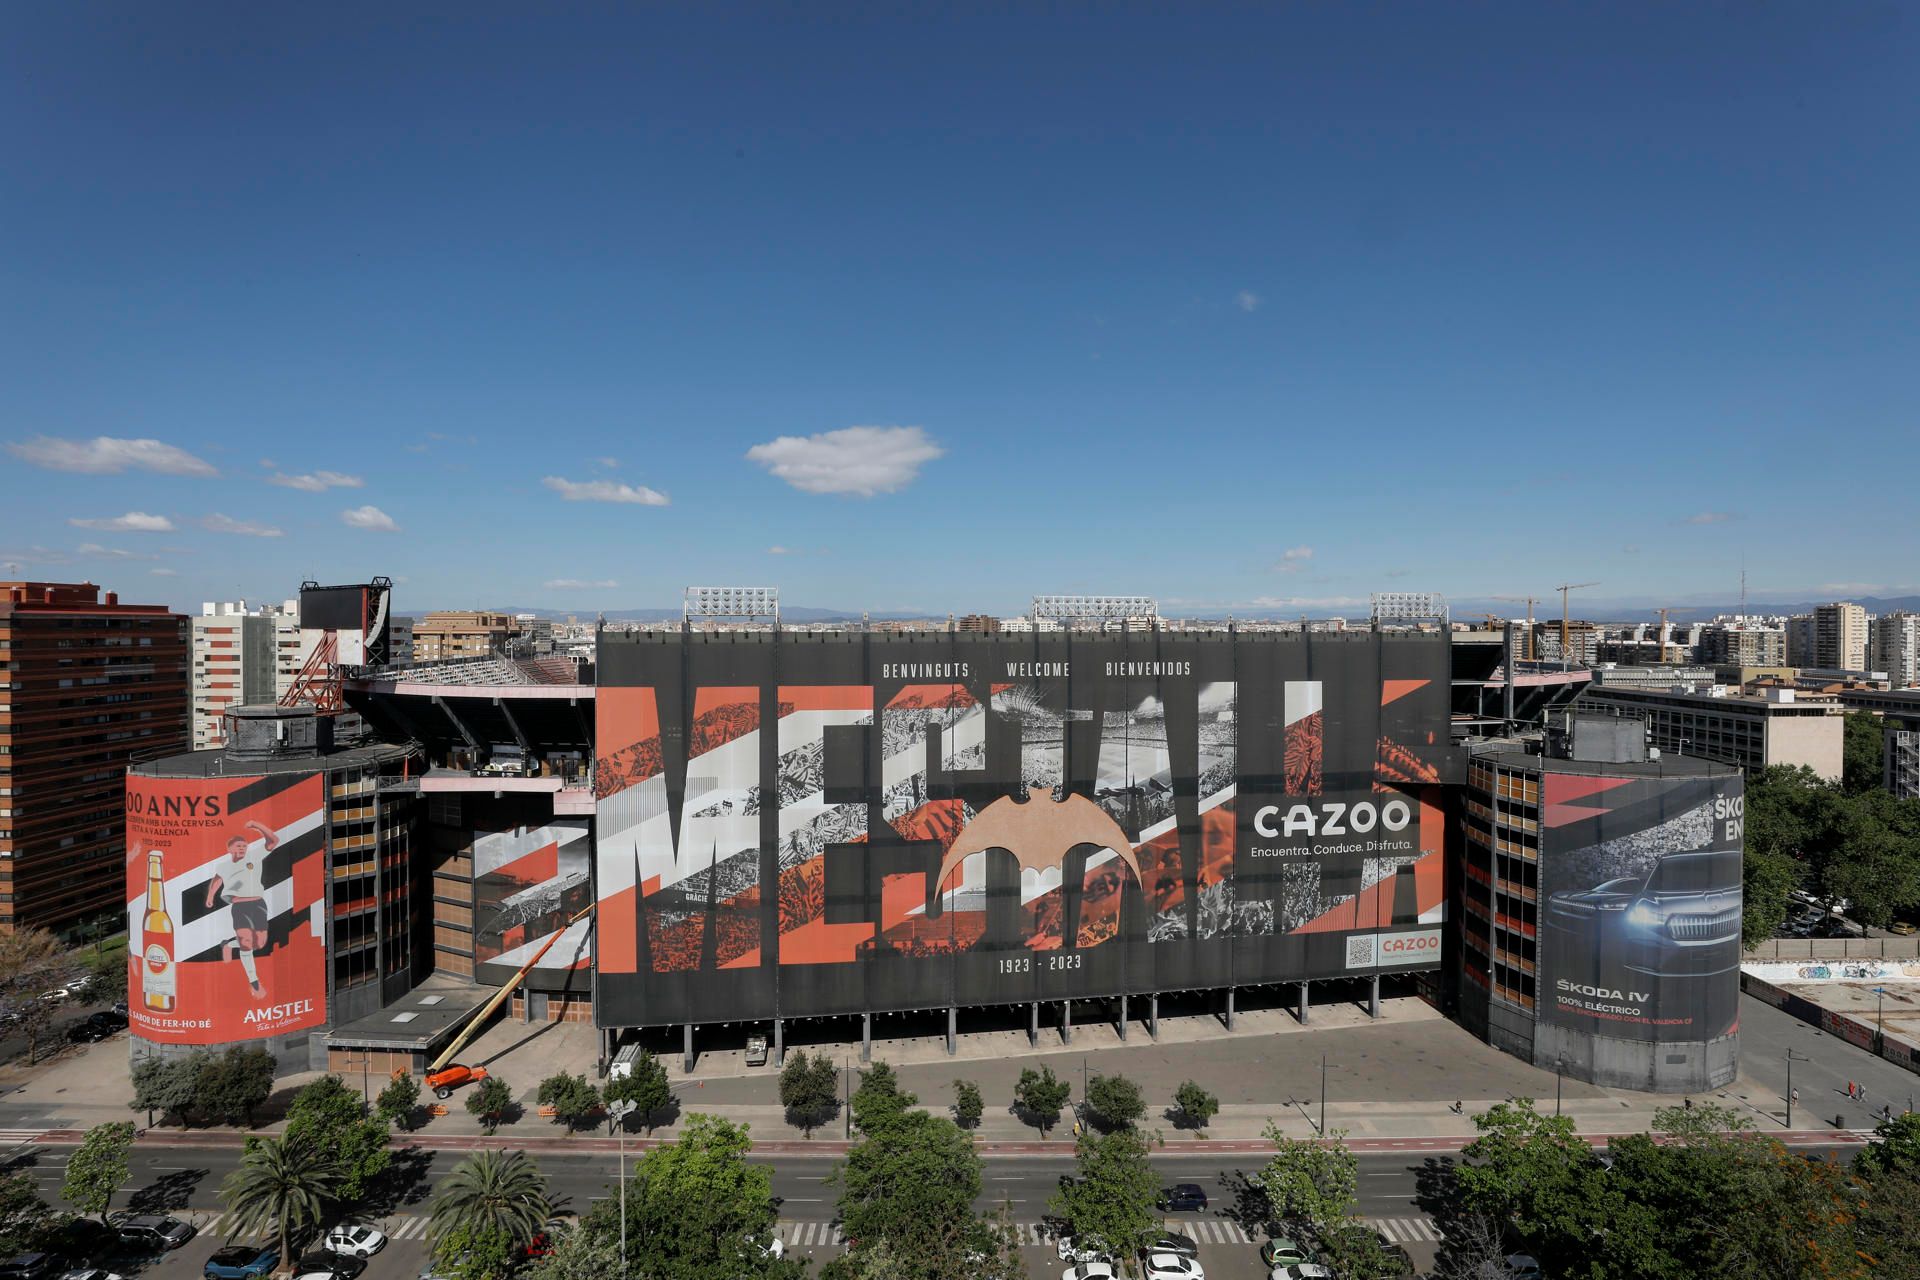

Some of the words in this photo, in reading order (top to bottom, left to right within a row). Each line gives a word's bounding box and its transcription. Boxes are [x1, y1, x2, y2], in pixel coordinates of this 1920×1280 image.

[882, 663, 969, 679] BENVINGUTS
[1006, 662, 1070, 677] WELCOME
[1106, 661, 1191, 676] BIENVENIDOS
[147, 795, 221, 817] ANYS
[181, 819, 225, 828] CERVESA
[1253, 800, 1411, 838] CAZOO
[1251, 846, 1312, 857] Encuentra.
[1313, 843, 1364, 855] Conduce.
[1366, 840, 1413, 852] Disfruta.
[1383, 936, 1439, 952] CAZOO
[1000, 958, 1030, 974] 1923
[1050, 954, 1081, 970] 2023
[1556, 979, 1624, 1001] ŠKODA
[243, 999, 314, 1024] AMSTEL
[1556, 995, 1583, 1008] 100%
[1584, 1001, 1641, 1016] ELÉCTRICO
[132, 1011, 151, 1024] SABOR
[151, 1017, 161, 1027] DE
[162, 1019, 197, 1028] FER-HO
[198, 1018, 212, 1029] BÉ
[1624, 1015, 1641, 1023] CON
